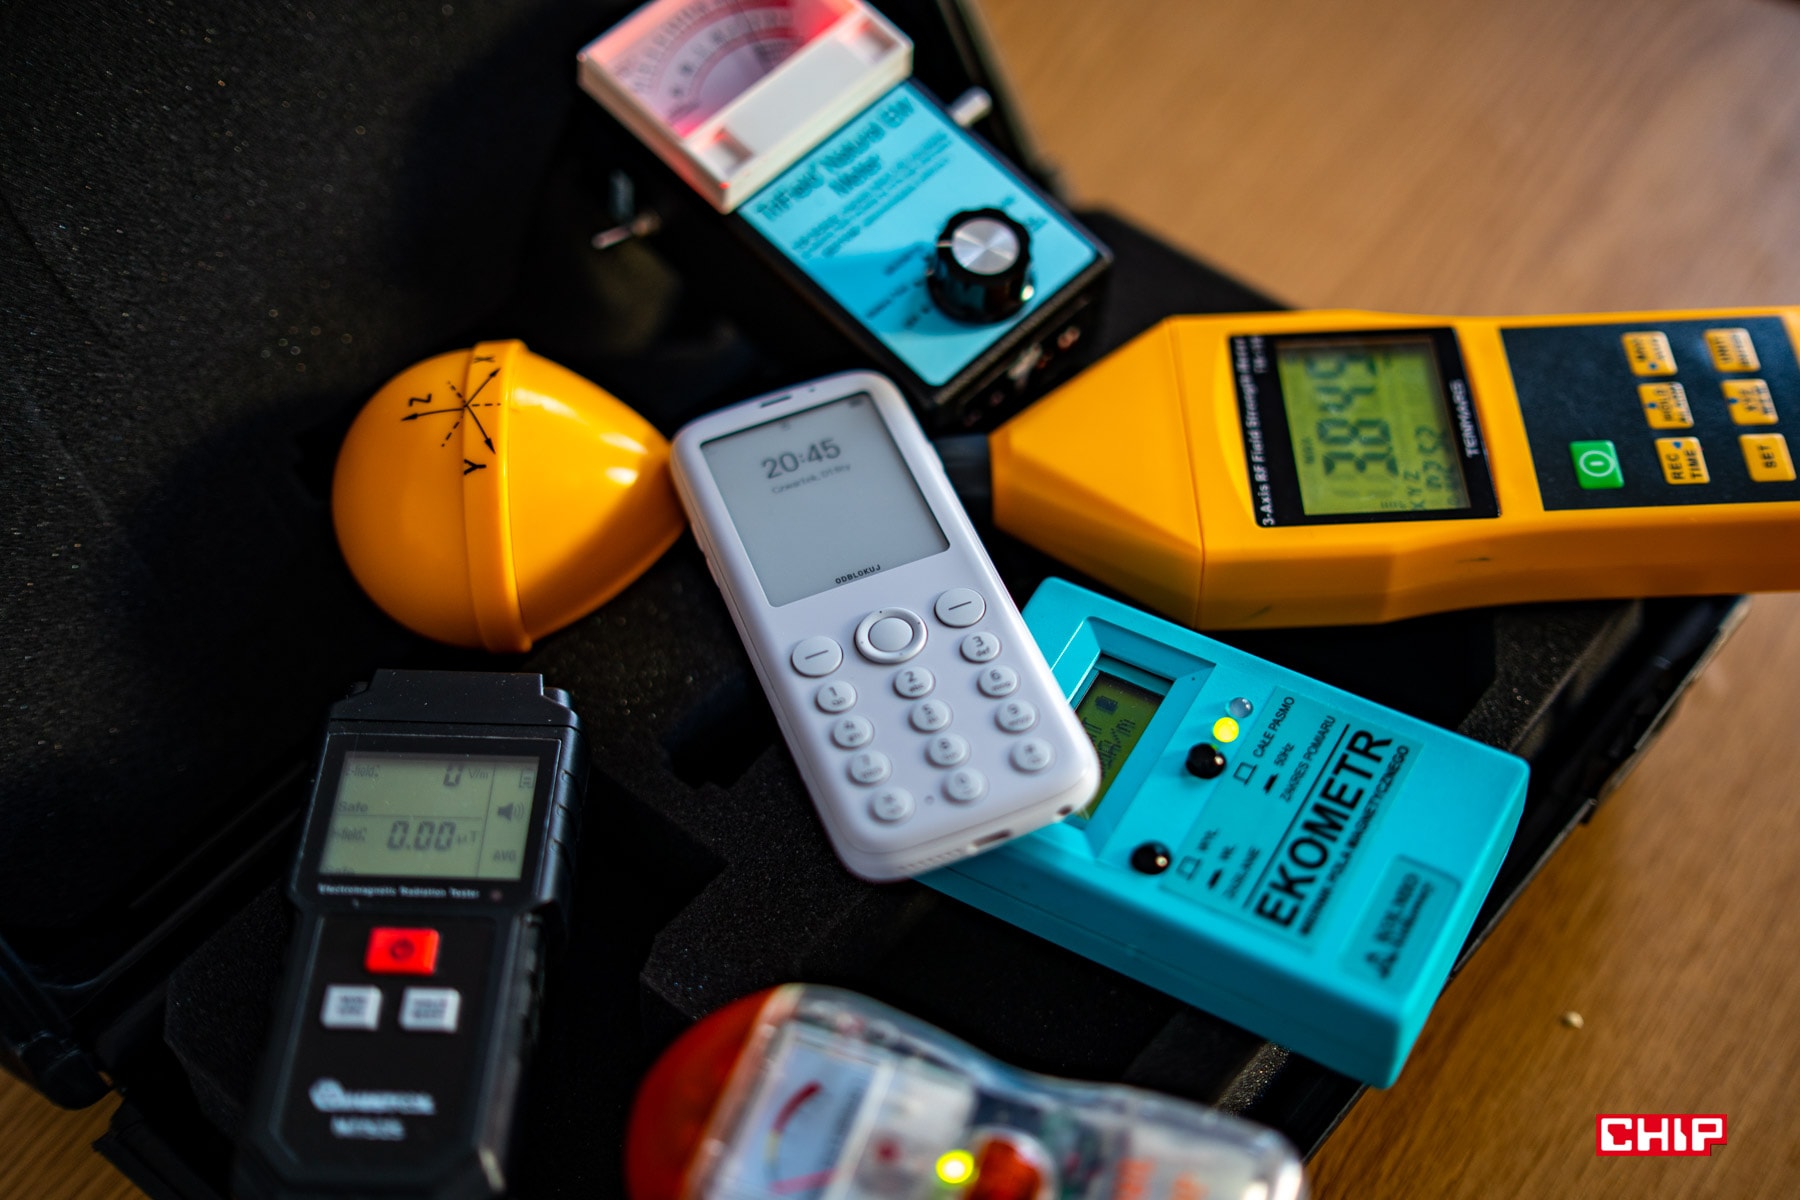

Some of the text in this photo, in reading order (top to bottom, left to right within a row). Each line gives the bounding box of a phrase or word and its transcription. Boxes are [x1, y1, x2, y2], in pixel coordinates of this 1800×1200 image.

[761, 437, 841, 479] 20:45
[1247, 429, 1265, 463] Field
[1757, 445, 1778, 469] SET
[463, 458, 487, 476] Y
[1253, 464, 1269, 482] RF
[1665, 453, 1684, 480] REC
[1684, 449, 1703, 480] TIME
[1257, 483, 1276, 526] 3-Axis
[835, 563, 881, 584] ODBLOKUJ
[972, 635, 984, 648] 3
[904, 670, 916, 683] 2
[989, 669, 1001, 681] 6
[829, 686, 837, 697] 1
[922, 703, 934, 716] 5
[1007, 703, 1020, 716] 9
[1252, 696, 1295, 758] CAŁE PASMO
[1273, 742, 1295, 768] 50Hz
[1279, 715, 1336, 803] ZAKRES POMIARU
[1348, 745, 1409, 849] MAGNETYCZNEGO
[387, 820, 457, 851] 0.00
[1254, 729, 1393, 928] EKOMETR
[492, 849, 518, 862] AVG
[318, 883, 397, 898] Electromagnetic
[399, 885, 447, 899] Radiation
